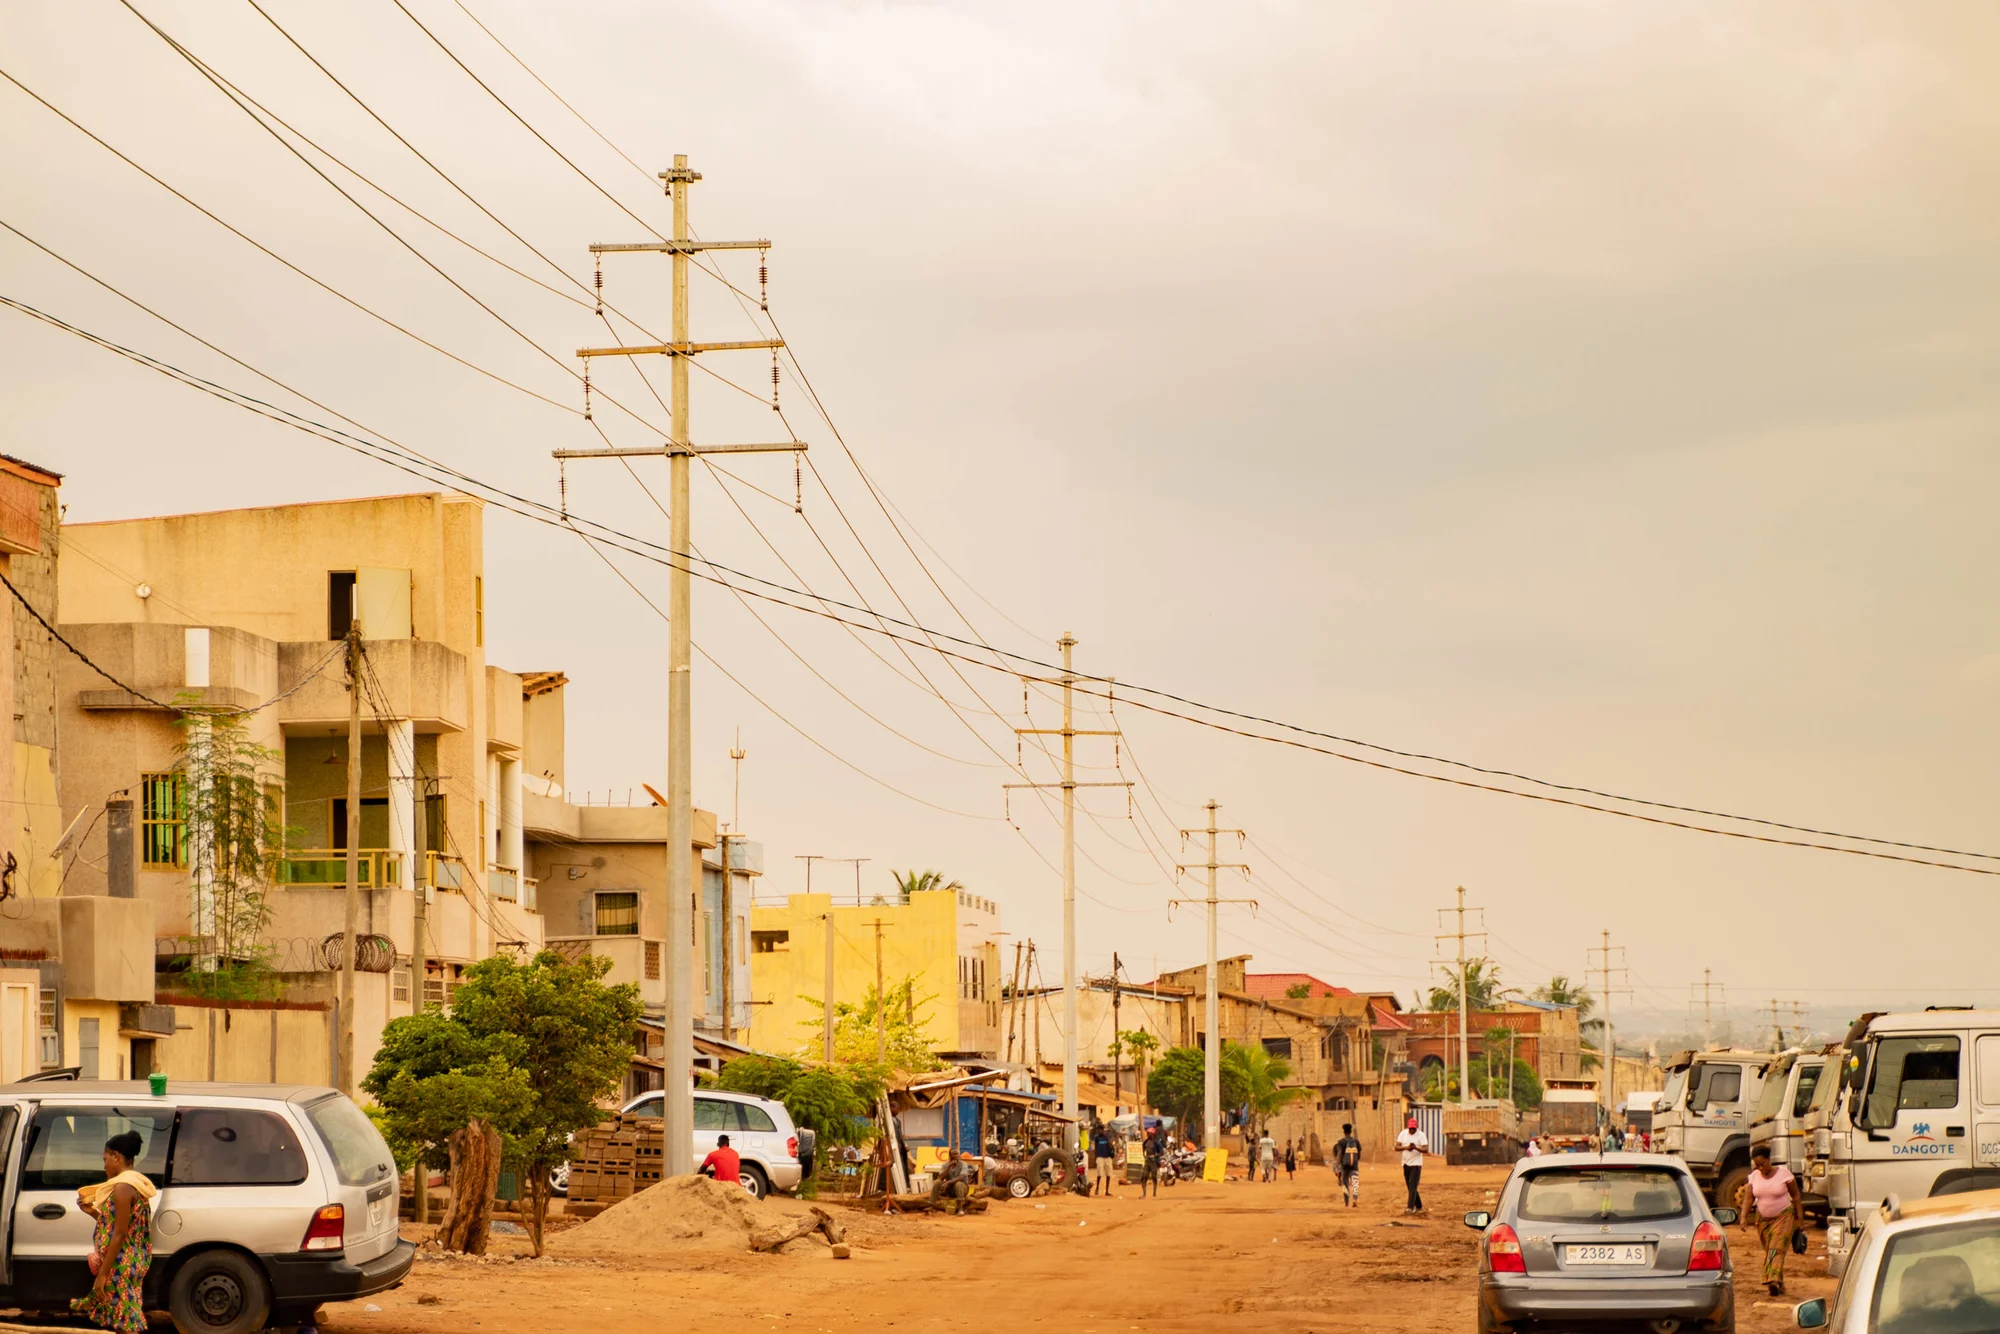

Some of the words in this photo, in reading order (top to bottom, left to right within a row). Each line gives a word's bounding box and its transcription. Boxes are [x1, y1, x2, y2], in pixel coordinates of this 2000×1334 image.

[1892, 1144, 1955, 1155] DANGOTE
[1580, 1247, 1615, 1260] 2382
[1625, 1247, 1643, 1260] AS
